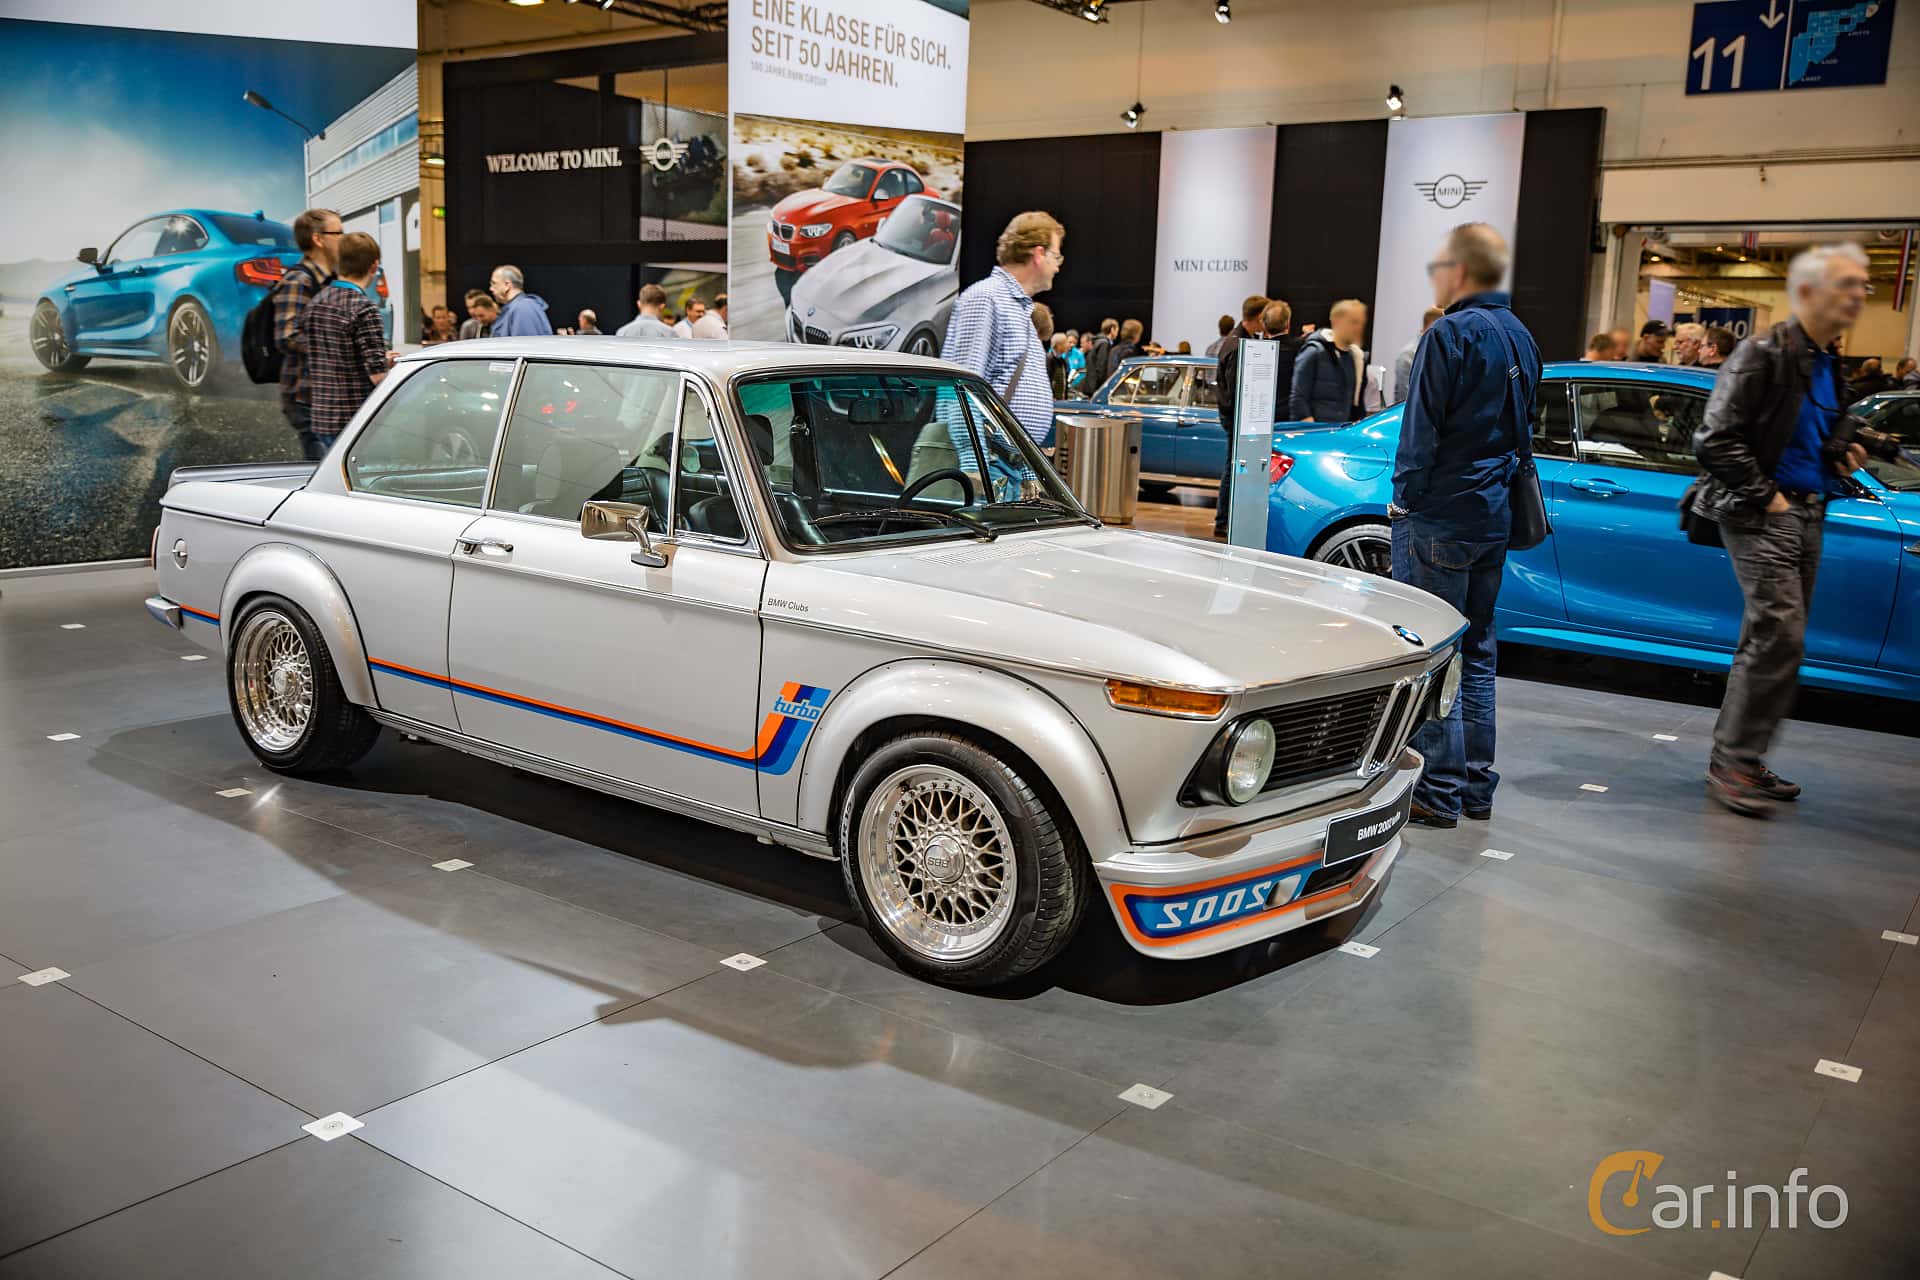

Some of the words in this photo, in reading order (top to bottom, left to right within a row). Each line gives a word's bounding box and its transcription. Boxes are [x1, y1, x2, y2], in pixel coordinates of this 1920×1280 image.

[752, 0, 796, 27] EINE
[801, 5, 870, 48] KLASSE
[874, 24, 906, 57] FÜR
[910, 36, 951, 70] SICH.
[751, 26, 794, 61] SEIT
[799, 40, 821, 68] 50
[825, 47, 898, 88] JAHREN.
[1692, 35, 1746, 90] 11
[486, 152, 560, 173] WELCOME
[560, 150, 582, 170] TO
[582, 147, 622, 169] MINI.
[1438, 187, 1462, 196] MINI
[1173, 259, 1204, 272] MINI
[1207, 259, 1249, 272] CLUBS
[768, 598, 787, 608] BMW
[788, 601, 809, 612] Clubs
[773, 695, 820, 721] turbo
[1357, 823, 1378, 841] BMW
